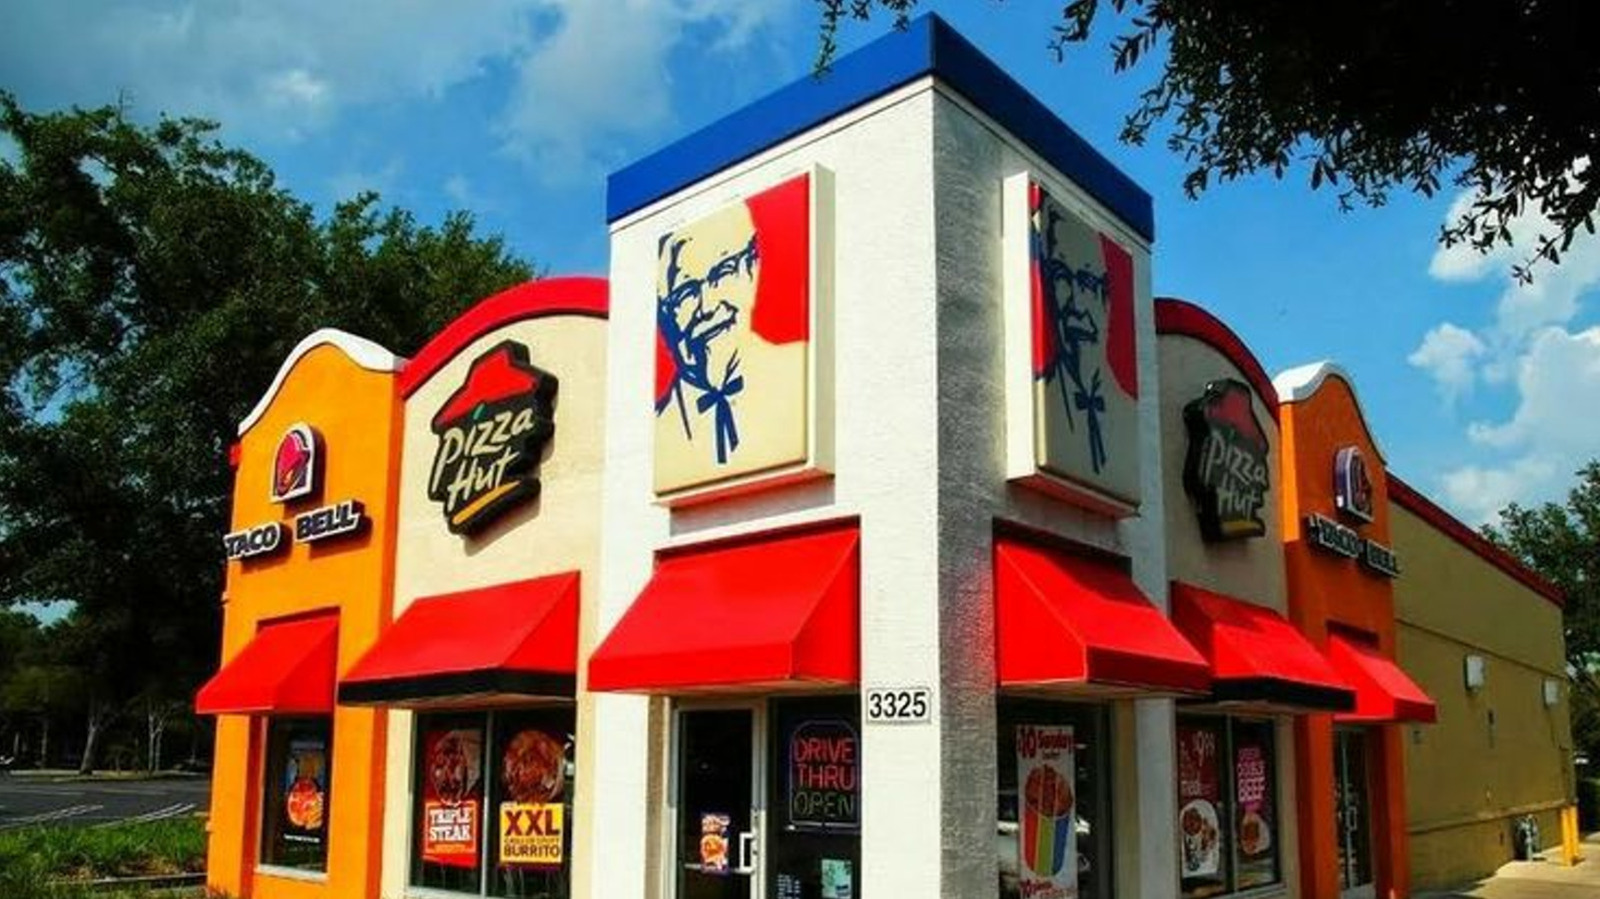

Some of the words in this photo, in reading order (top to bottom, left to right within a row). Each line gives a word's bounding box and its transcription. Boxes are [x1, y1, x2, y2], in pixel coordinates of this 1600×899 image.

[431, 403, 535, 493] Pizza
[1204, 428, 1267, 487] Pizza
[447, 446, 521, 512] Hut
[223, 521, 281, 560] TACO
[295, 500, 360, 543] BELL
[869, 691, 927, 719] 3325
[793, 736, 854, 763] DRIVE
[796, 763, 856, 790] THRU
[429, 807, 472, 824] TRIPLE
[793, 791, 854, 818] OPEN
[429, 824, 472, 842] STEAK
[503, 809, 561, 836] XXL
[503, 844, 561, 859] BURRITO
